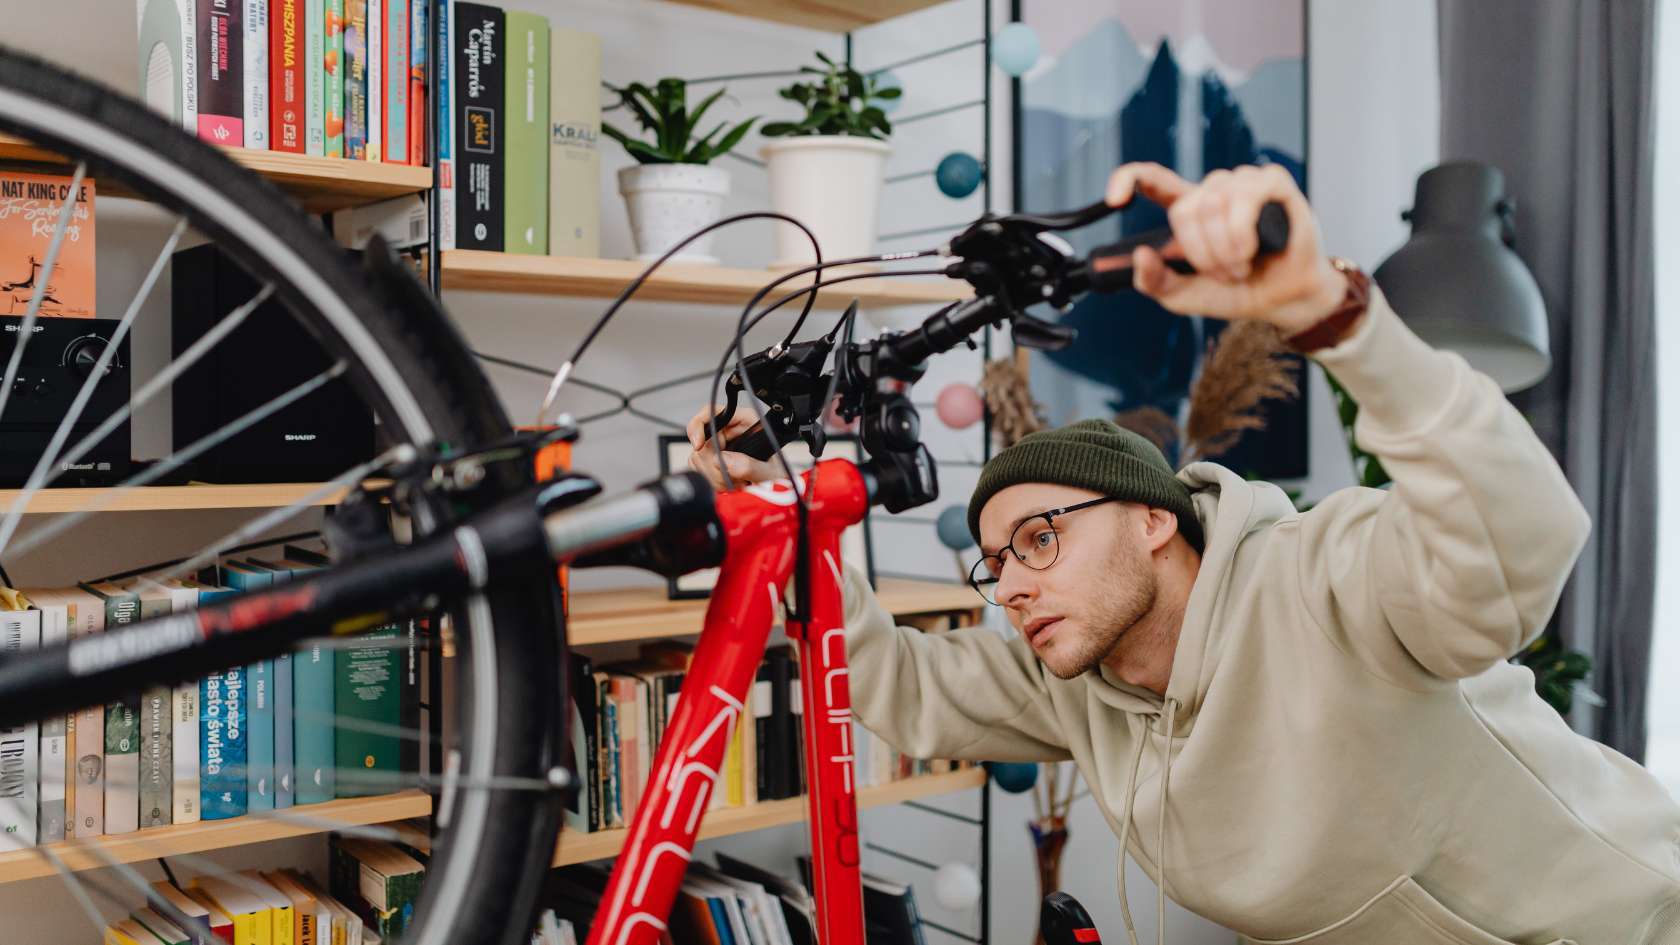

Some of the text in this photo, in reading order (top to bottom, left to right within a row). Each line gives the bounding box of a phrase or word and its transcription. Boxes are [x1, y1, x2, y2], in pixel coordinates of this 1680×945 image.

[283, 0, 295, 67] HISZPANIA
[482, 20, 496, 65] Martín
[464, 28, 486, 98] Caparrós
[187, 77, 195, 111] POLSKU
[2, 181, 24, 199] NAT
[28, 183, 56, 200] KING
[114, 601, 135, 624] Olga
[207, 672, 225, 776] iasto świata
[302, 914, 311, 937] Jacek
